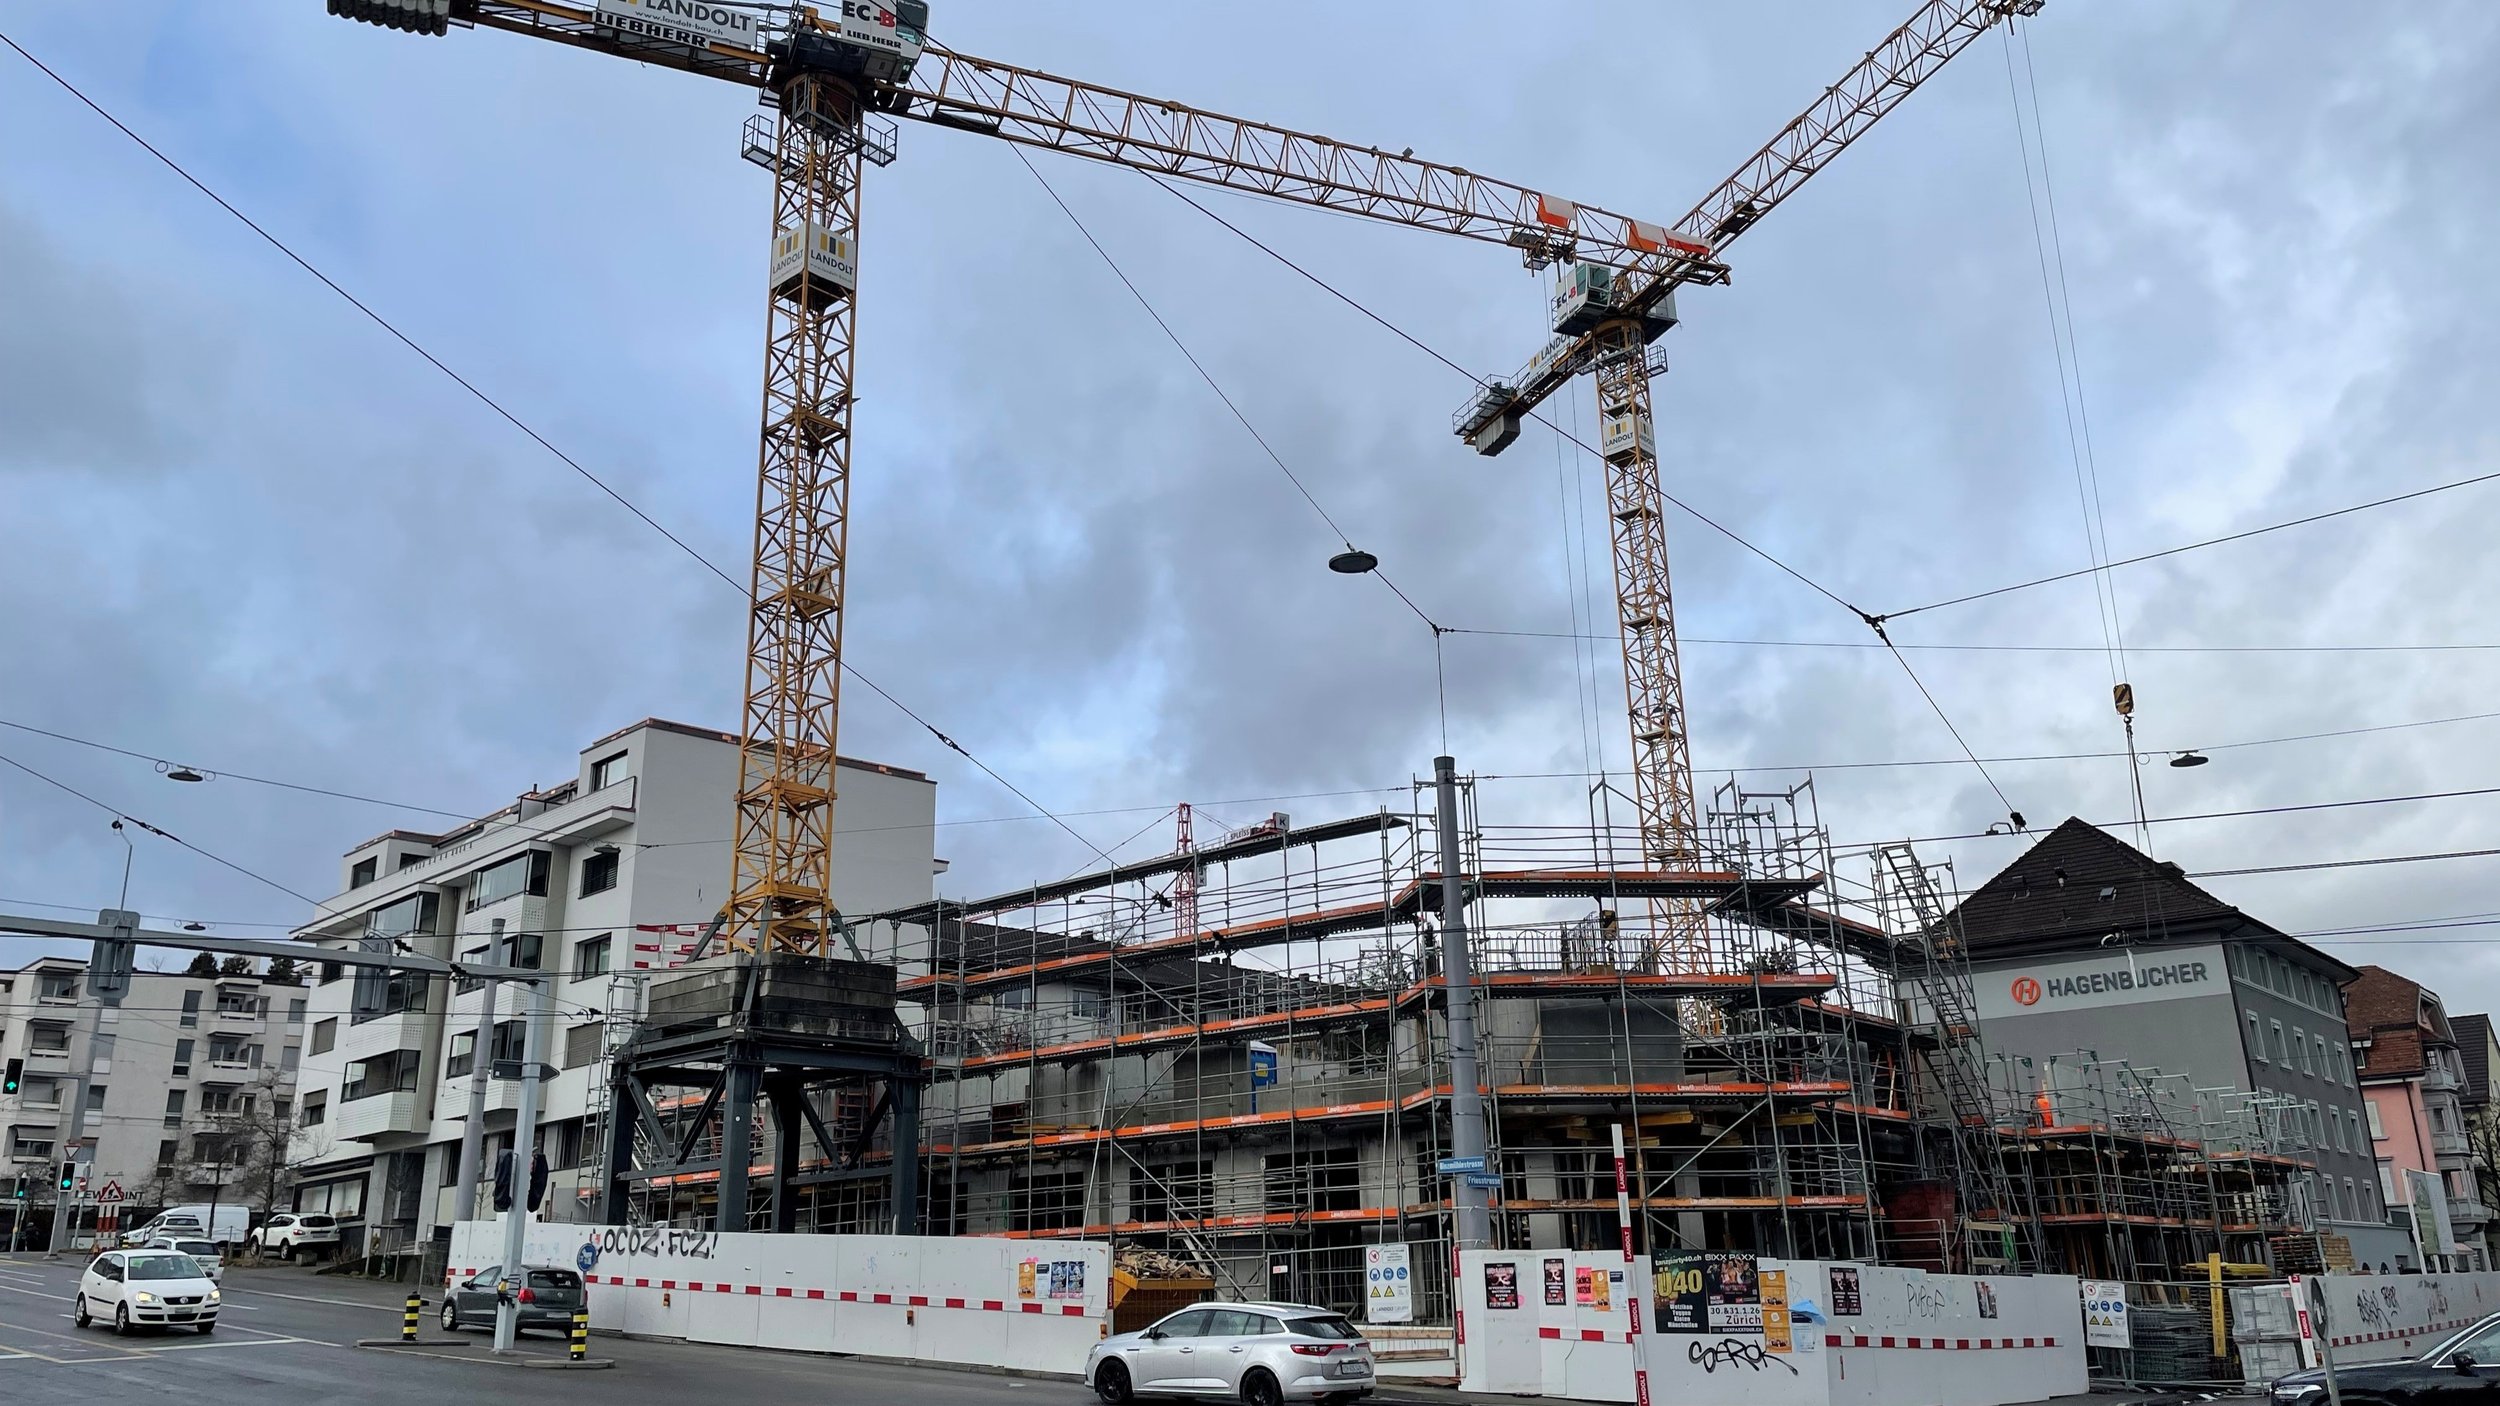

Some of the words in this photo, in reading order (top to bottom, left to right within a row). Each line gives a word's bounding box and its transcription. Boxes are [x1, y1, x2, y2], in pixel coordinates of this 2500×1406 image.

[645, 0, 752, 32] LANDOLT
[842, 0, 896, 28] EC-B
[596, 12, 706, 48] LIEBHERR
[772, 249, 804, 274] LANDOLT
[810, 249, 854, 275] LANDOLT
[1605, 432, 1634, 447] LANDOLT
[2047, 962, 2208, 998] HAGENBUCHER
[1617, 1161, 1625, 1190] LANDOLT
[1624, 1230, 1632, 1260] LANDOLT
[1704, 1253, 1727, 1261] SIXX
[1729, 1253, 1755, 1261] PAXX
[1654, 1255, 1702, 1266] tanzparty40.ch
[1656, 1266, 1703, 1297] Ü40
[1631, 1301, 1640, 1331] LANDOLT
[1725, 1314, 1762, 1325] Zürich
[2301, 1313, 2312, 1338] LANDOLT
[1639, 1373, 1649, 1405] LANDOLT
